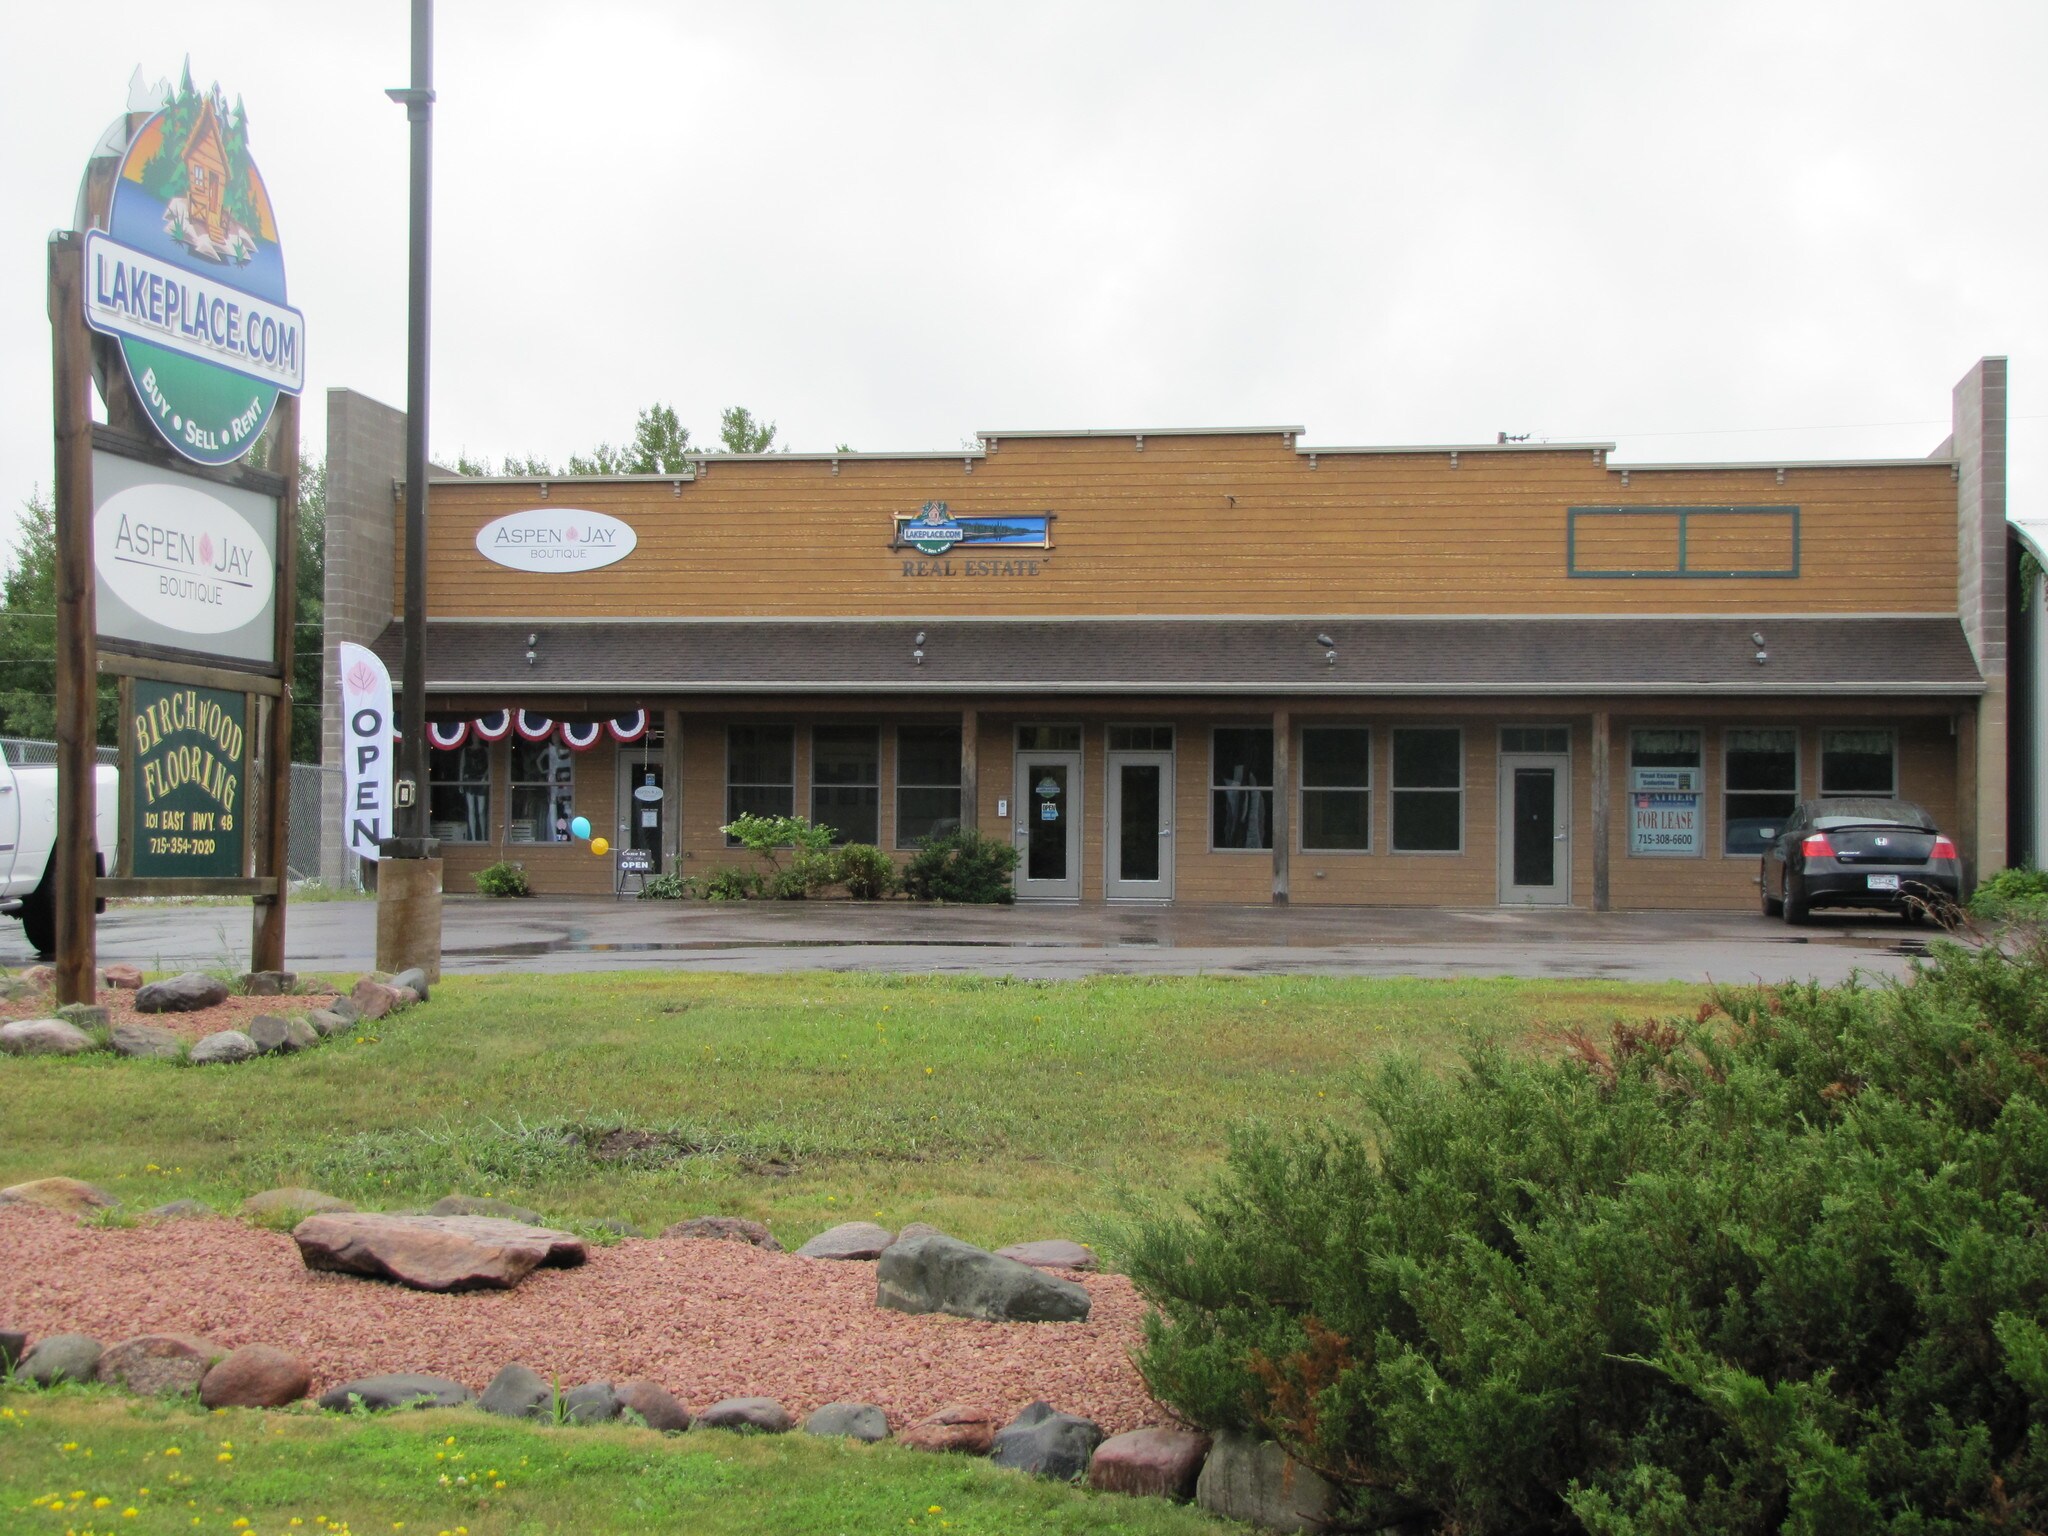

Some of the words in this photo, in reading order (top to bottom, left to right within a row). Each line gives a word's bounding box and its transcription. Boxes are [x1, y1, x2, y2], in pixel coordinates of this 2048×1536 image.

[97, 254, 297, 372] LAKEPLACE.COM
[142, 367, 171, 418] BUY
[185, 420, 219, 450] SELL
[231, 396, 262, 442] RENT
[495, 526, 562, 543] ASPEN
[580, 526, 616, 543] JAY
[905, 530, 961, 539] LAKEPLACE.COM
[115, 513, 195, 565] ASPEN
[215, 538, 253, 577] JAY
[530, 549, 587, 559] BOUTIQUE
[902, 559, 957, 577] REAL
[964, 559, 1041, 577] ESTATE
[160, 575, 223, 606] BOUTIQUE
[136, 690, 242, 762] BIRCHWOOD
[143, 745, 237, 813] FLOORING
[352, 708, 383, 847] OPEN
[145, 812, 159, 829] 101
[162, 811, 185, 831] EAST
[192, 812, 215, 831] HWY.
[220, 814, 233, 831] 48
[1637, 811, 1658, 829] FOR
[1661, 811, 1694, 830] LEASE
[150, 837, 216, 855] 715-354-7020
[1638, 834, 1693, 845] 715-308-6600
[621, 861, 649, 869] OPEN
